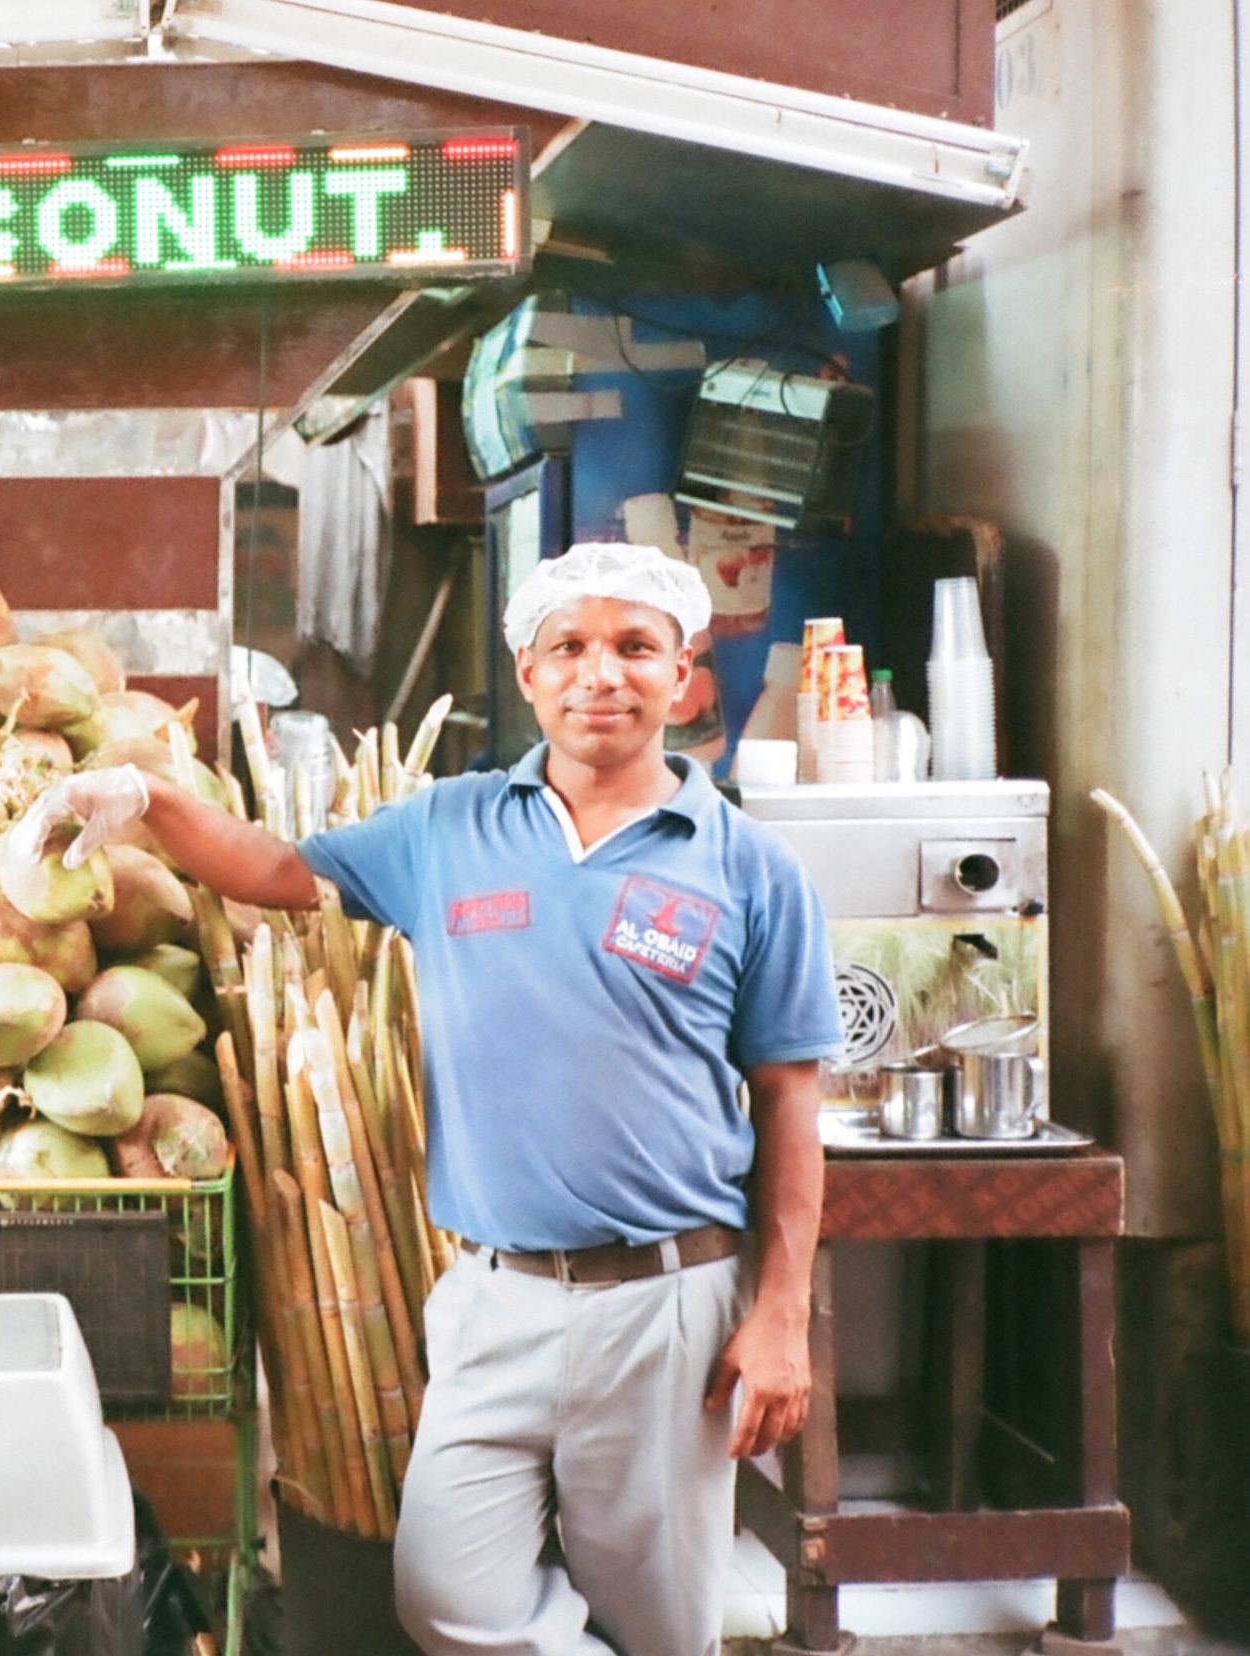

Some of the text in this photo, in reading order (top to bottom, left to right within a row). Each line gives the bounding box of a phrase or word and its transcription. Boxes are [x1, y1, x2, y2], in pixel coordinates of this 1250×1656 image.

[616, 919, 697, 963] AL OBAID
[616, 934, 687, 974] CAFETERIA
